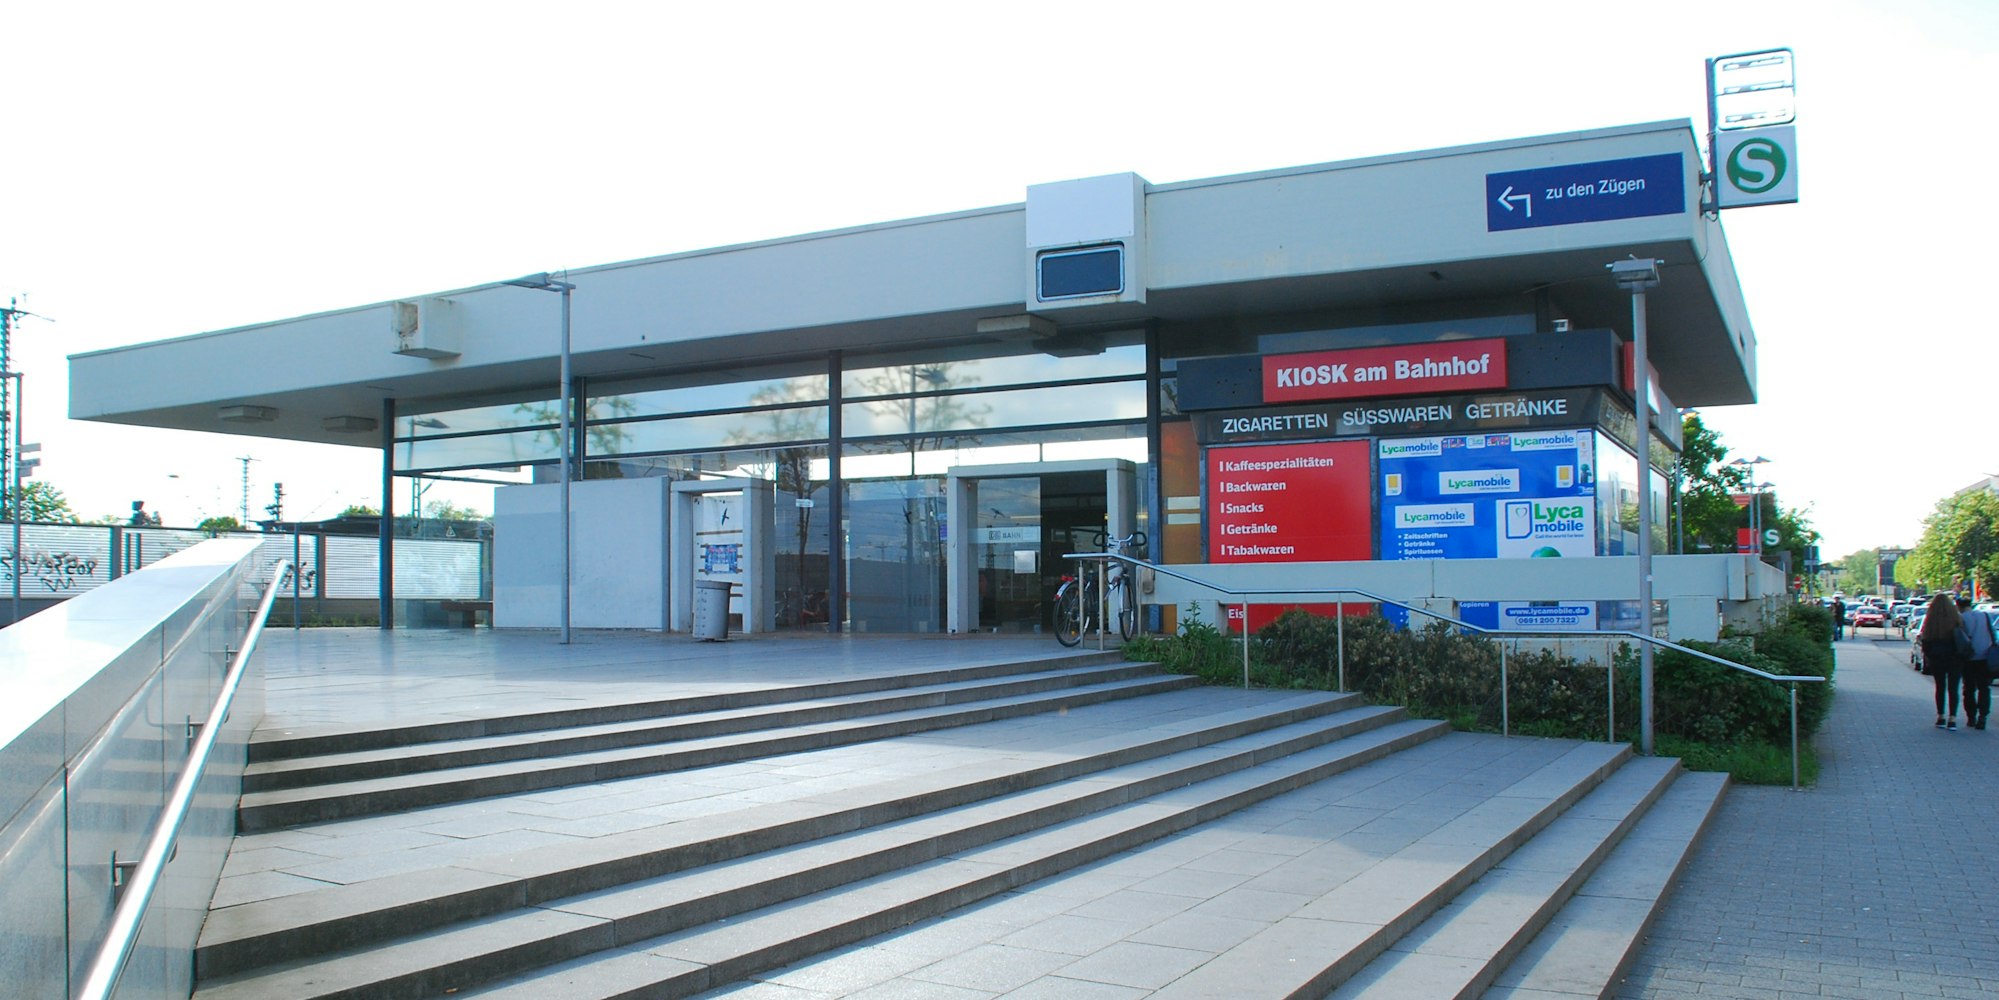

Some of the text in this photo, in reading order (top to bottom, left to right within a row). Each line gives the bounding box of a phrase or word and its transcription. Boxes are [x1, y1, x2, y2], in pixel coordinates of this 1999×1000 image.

[1732, 138, 1781, 192] S
[1545, 177, 1646, 200] zu den Zügen
[1276, 353, 1491, 388] KIOSK am Bahnhof
[1222, 398, 1568, 434] ZIGARETTEN SÜSSWAREN GETRÄNKE
[1513, 433, 1575, 448] Lycamobile
[1381, 442, 1439, 455] Lycamobile
[1225, 457, 1334, 472] Kaffeespezialitäten
[1226, 481, 1287, 493] Backwaren
[1448, 476, 1511, 490] Lycamobile
[1226, 502, 1264, 514] Snacks
[1534, 503, 1584, 523] Lyca
[1404, 509, 1466, 523] Lycamobile
[1226, 522, 1278, 535] Getränke
[1534, 520, 1584, 533] mobile
[1403, 532, 1448, 540] Zeitschriften
[1764, 528, 1781, 546] S
[1227, 544, 1295, 556] Tabakwaren
[1228, 608, 1244, 619] Eis
[1509, 608, 1586, 616] www.lycamobile.de
